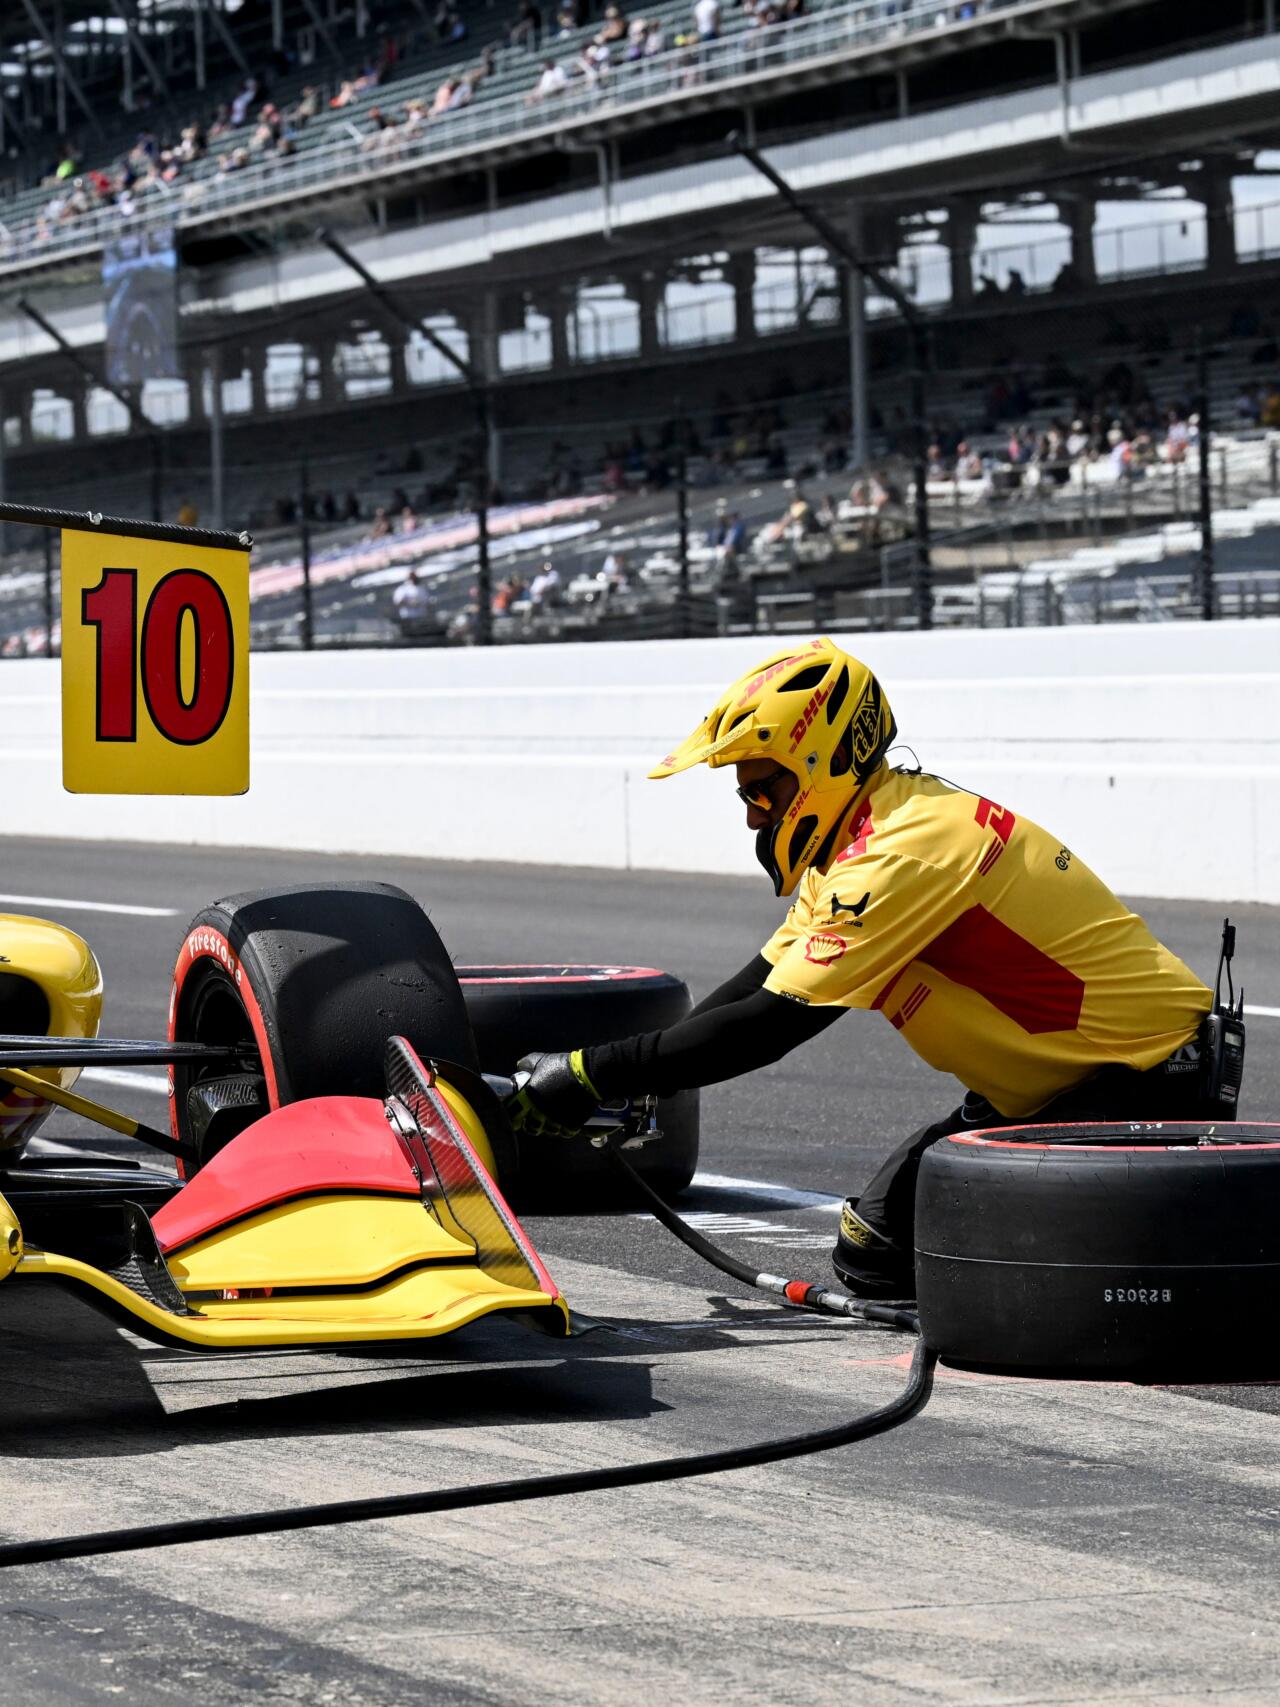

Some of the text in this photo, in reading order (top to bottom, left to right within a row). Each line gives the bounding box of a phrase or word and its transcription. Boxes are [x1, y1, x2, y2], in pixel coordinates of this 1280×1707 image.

[81, 567, 234, 745] 10
[789, 684, 830, 745] DHL
[789, 788, 811, 821] DHL
[188, 934, 241, 986] Firestone
